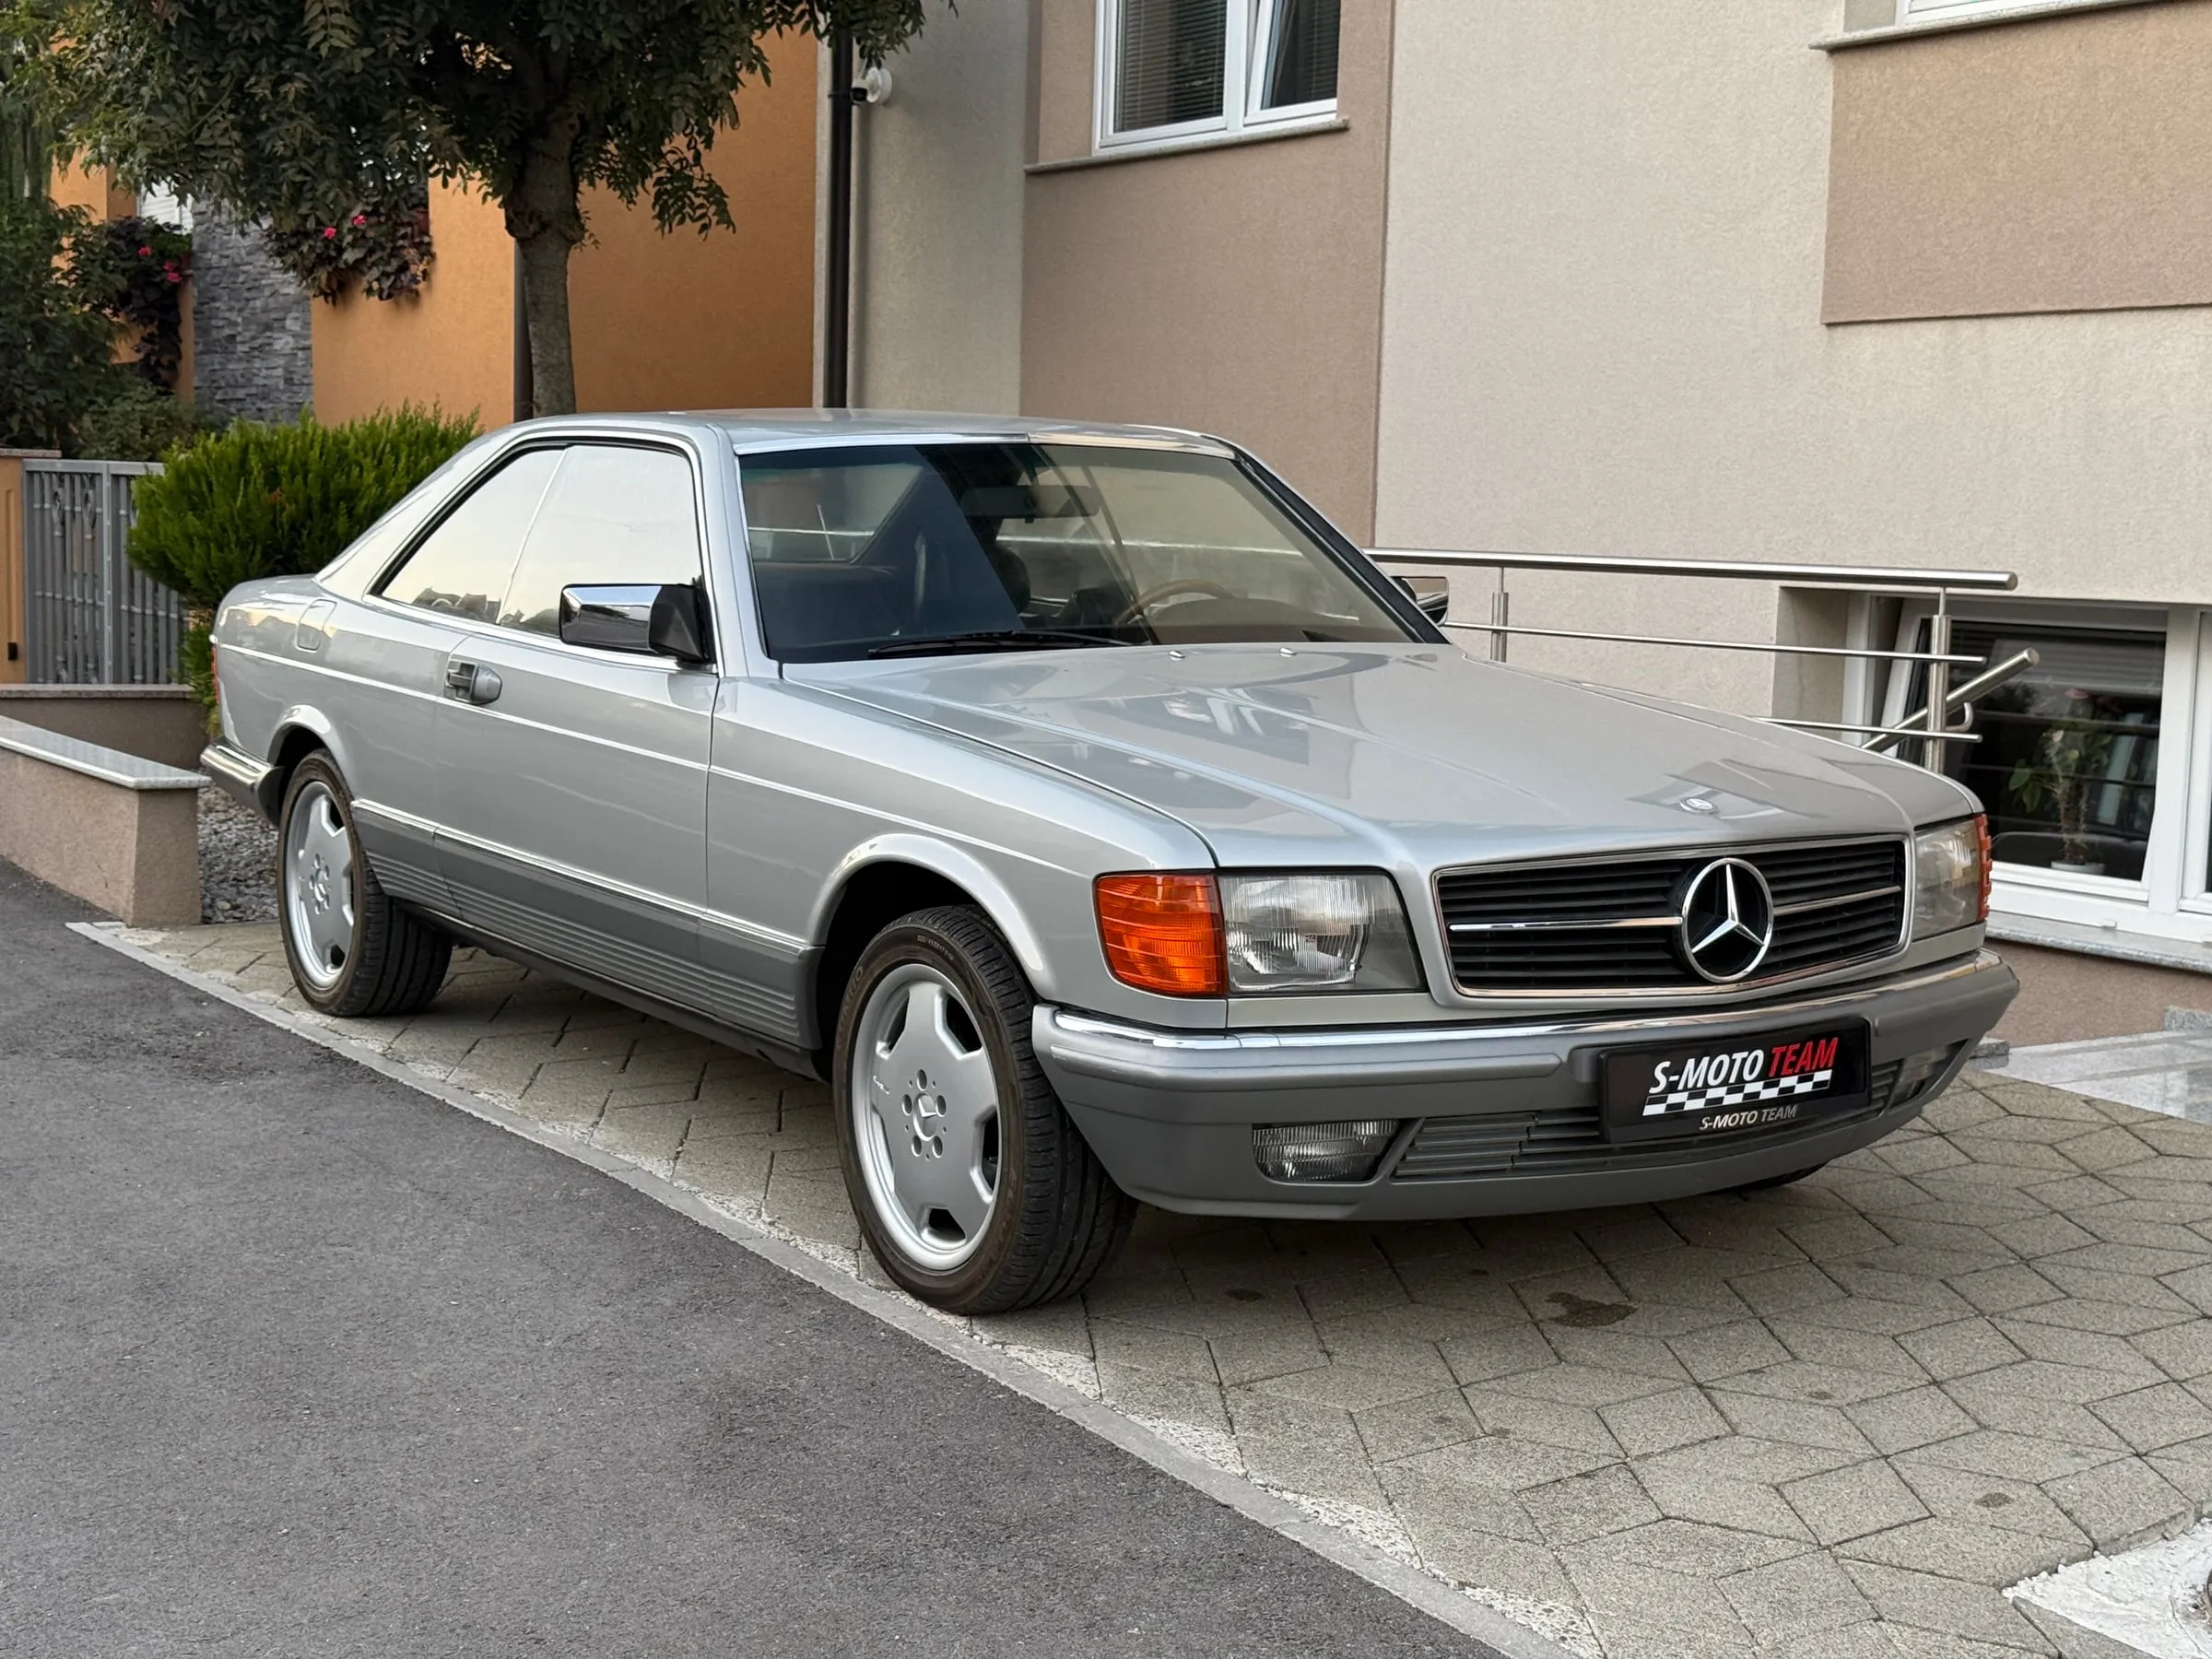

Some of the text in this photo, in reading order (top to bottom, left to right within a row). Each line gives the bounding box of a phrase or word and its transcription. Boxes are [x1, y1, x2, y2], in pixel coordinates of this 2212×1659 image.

[1649, 1037, 1839, 1094] S-MOTO TEAM
[1699, 1103, 1798, 1131] S-MOTO TEAM
